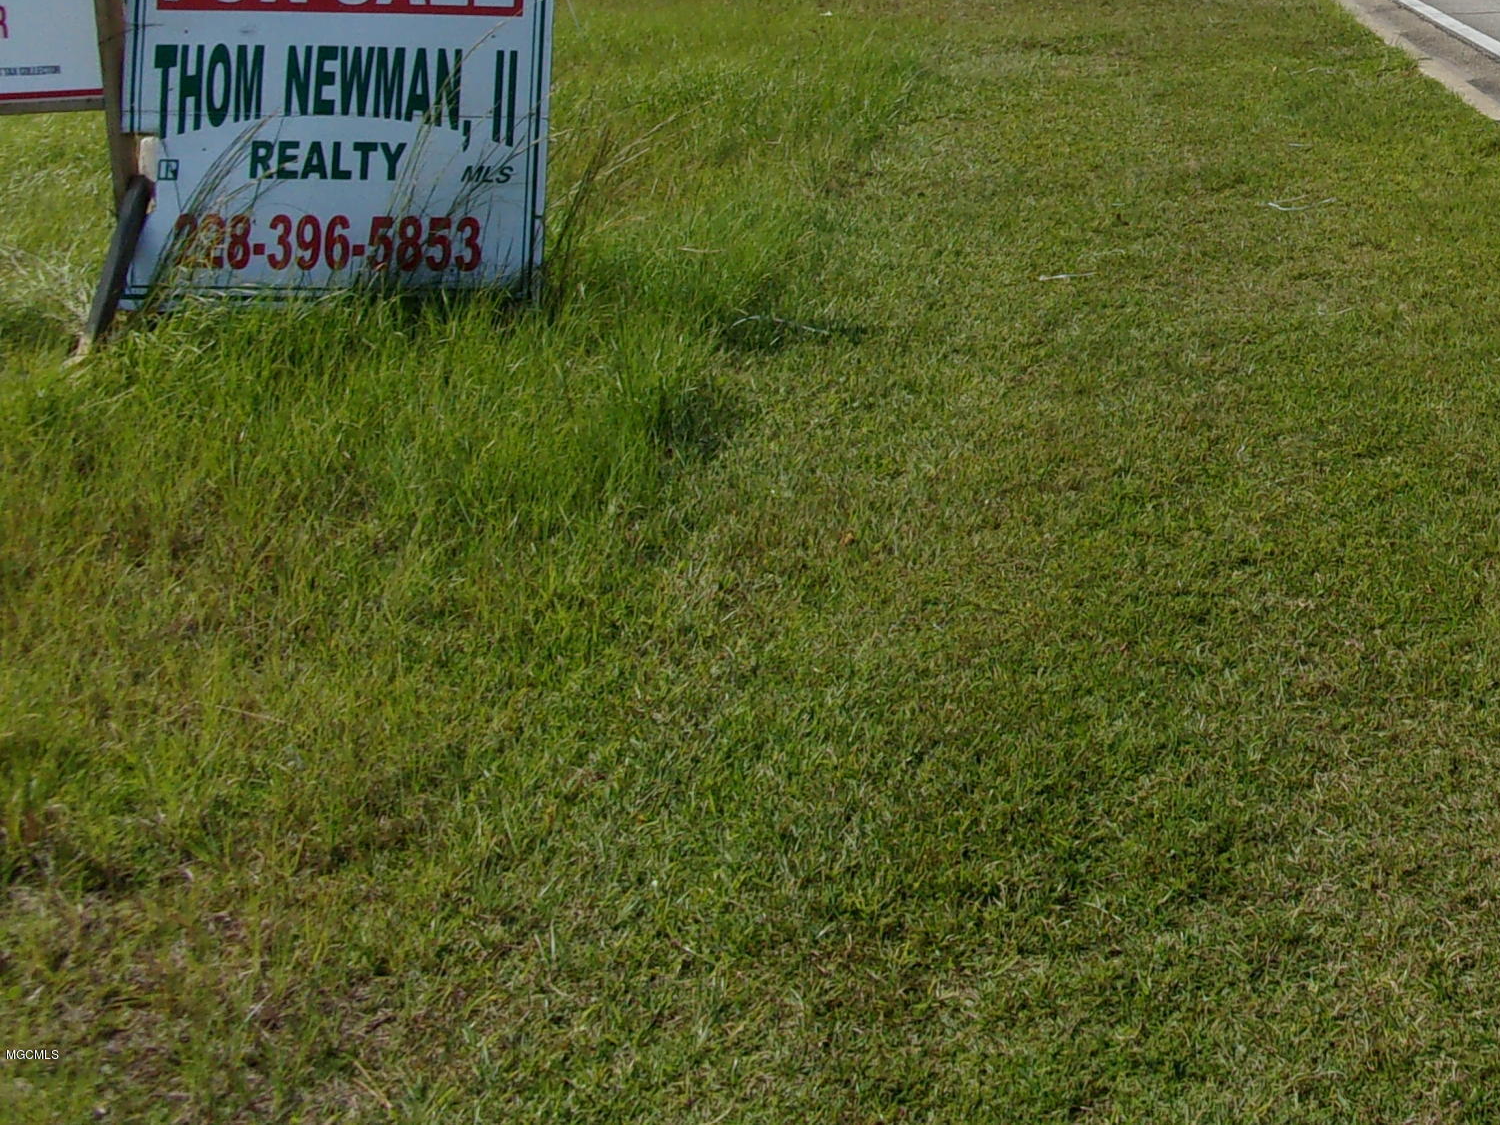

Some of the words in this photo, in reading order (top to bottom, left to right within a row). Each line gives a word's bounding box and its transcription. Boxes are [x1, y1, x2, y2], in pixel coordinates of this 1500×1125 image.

[154, 43, 265, 139] THOM
[284, 45, 472, 153] NEWMAN,
[492, 49, 518, 147] II
[249, 141, 407, 181] REALTY
[461, 165, 514, 184] MLS
